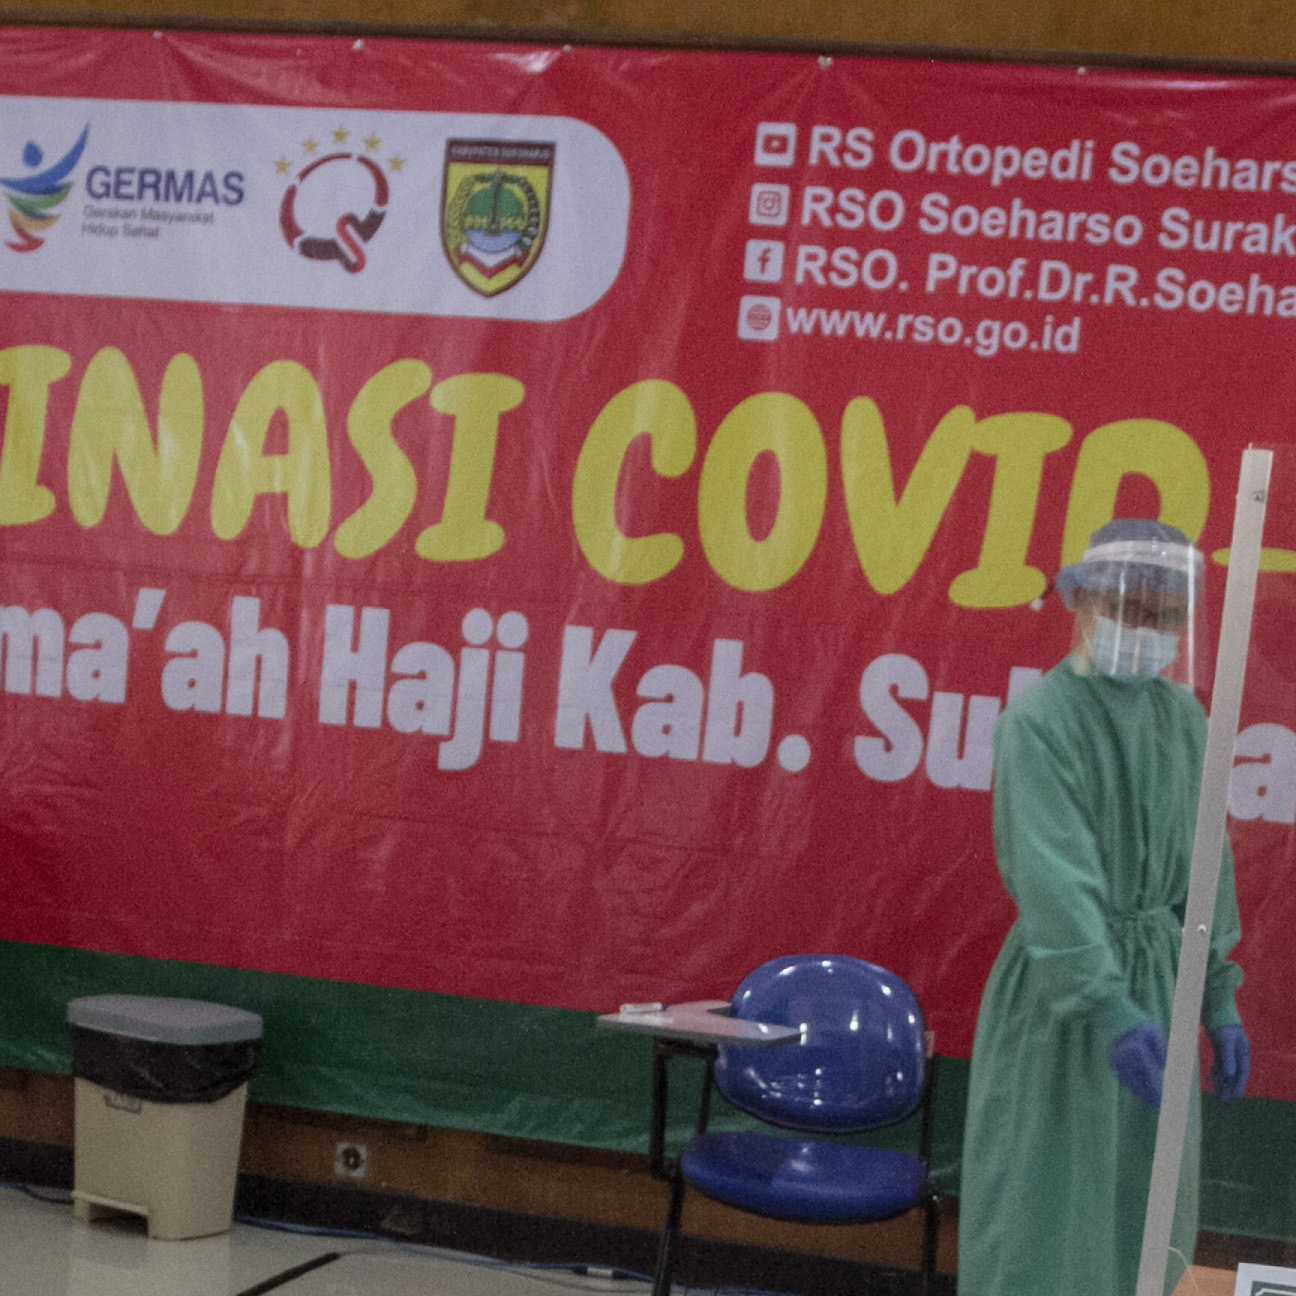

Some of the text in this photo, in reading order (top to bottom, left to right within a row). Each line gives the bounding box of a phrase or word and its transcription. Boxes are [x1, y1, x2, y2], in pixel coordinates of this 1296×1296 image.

[808, 124, 875, 170] RS
[888, 129, 1095, 187] Ortopedi
[85, 164, 245, 206] GERMAS
[81, 222, 119, 239] Hidup
[800, 185, 906, 232] RSO
[918, 191, 1144, 247] Soeharso
[793, 243, 909, 292] RSO.
[784, 305, 1082, 358] www.rso.go.id
[318, 602, 530, 773] Haji
[553, 624, 812, 772] Kab.
